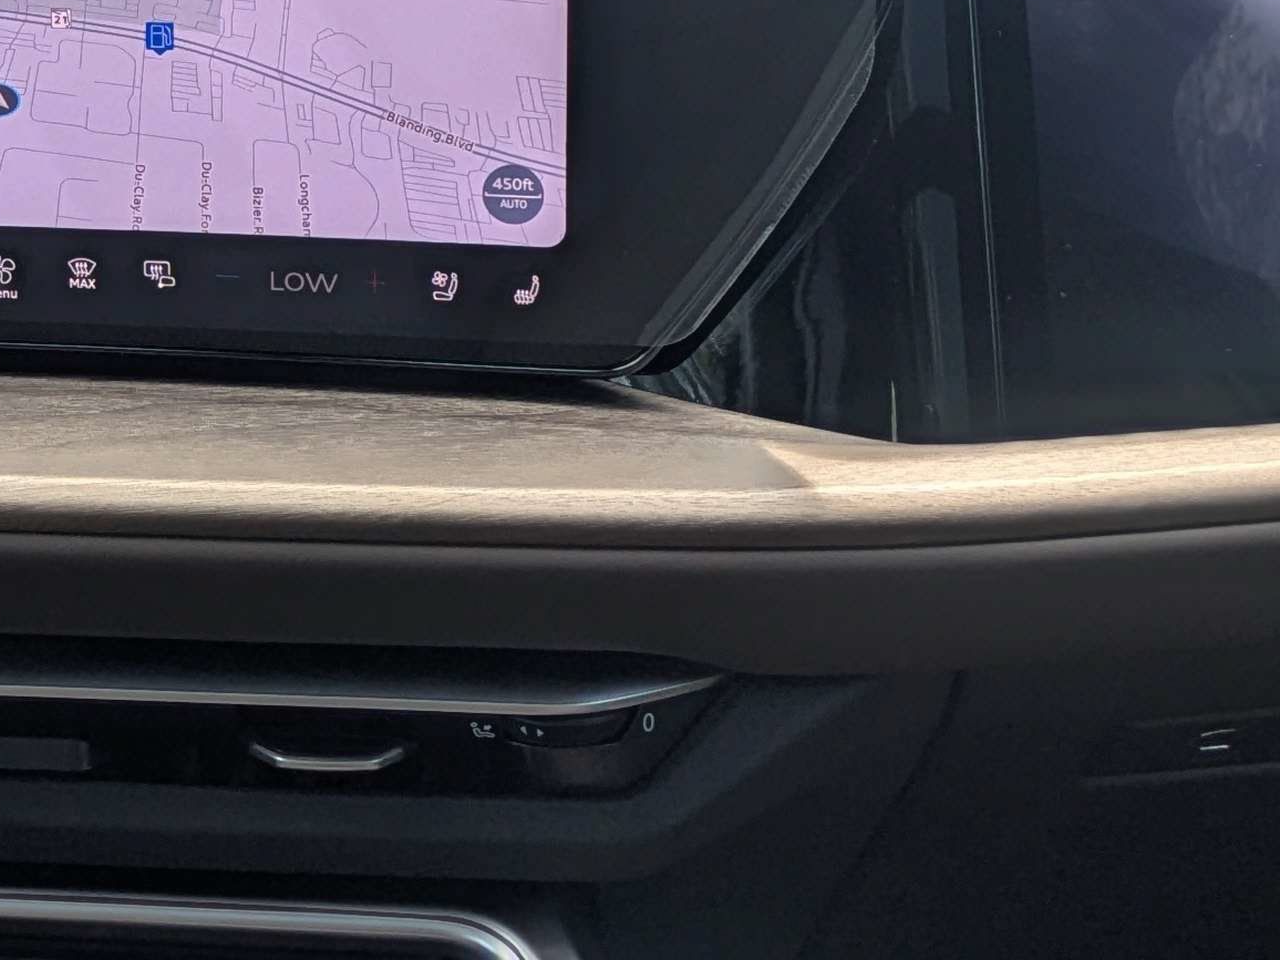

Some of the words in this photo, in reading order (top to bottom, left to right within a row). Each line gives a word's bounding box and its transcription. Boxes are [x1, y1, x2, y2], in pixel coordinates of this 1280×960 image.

[386, 111, 445, 144] Blanding
[445, 133, 474, 153] Blvd
[492, 177, 535, 192] 450ft
[499, 199, 528, 210] AUTO
[69, 278, 97, 290] MAX
[269, 270, 339, 294] LOW
